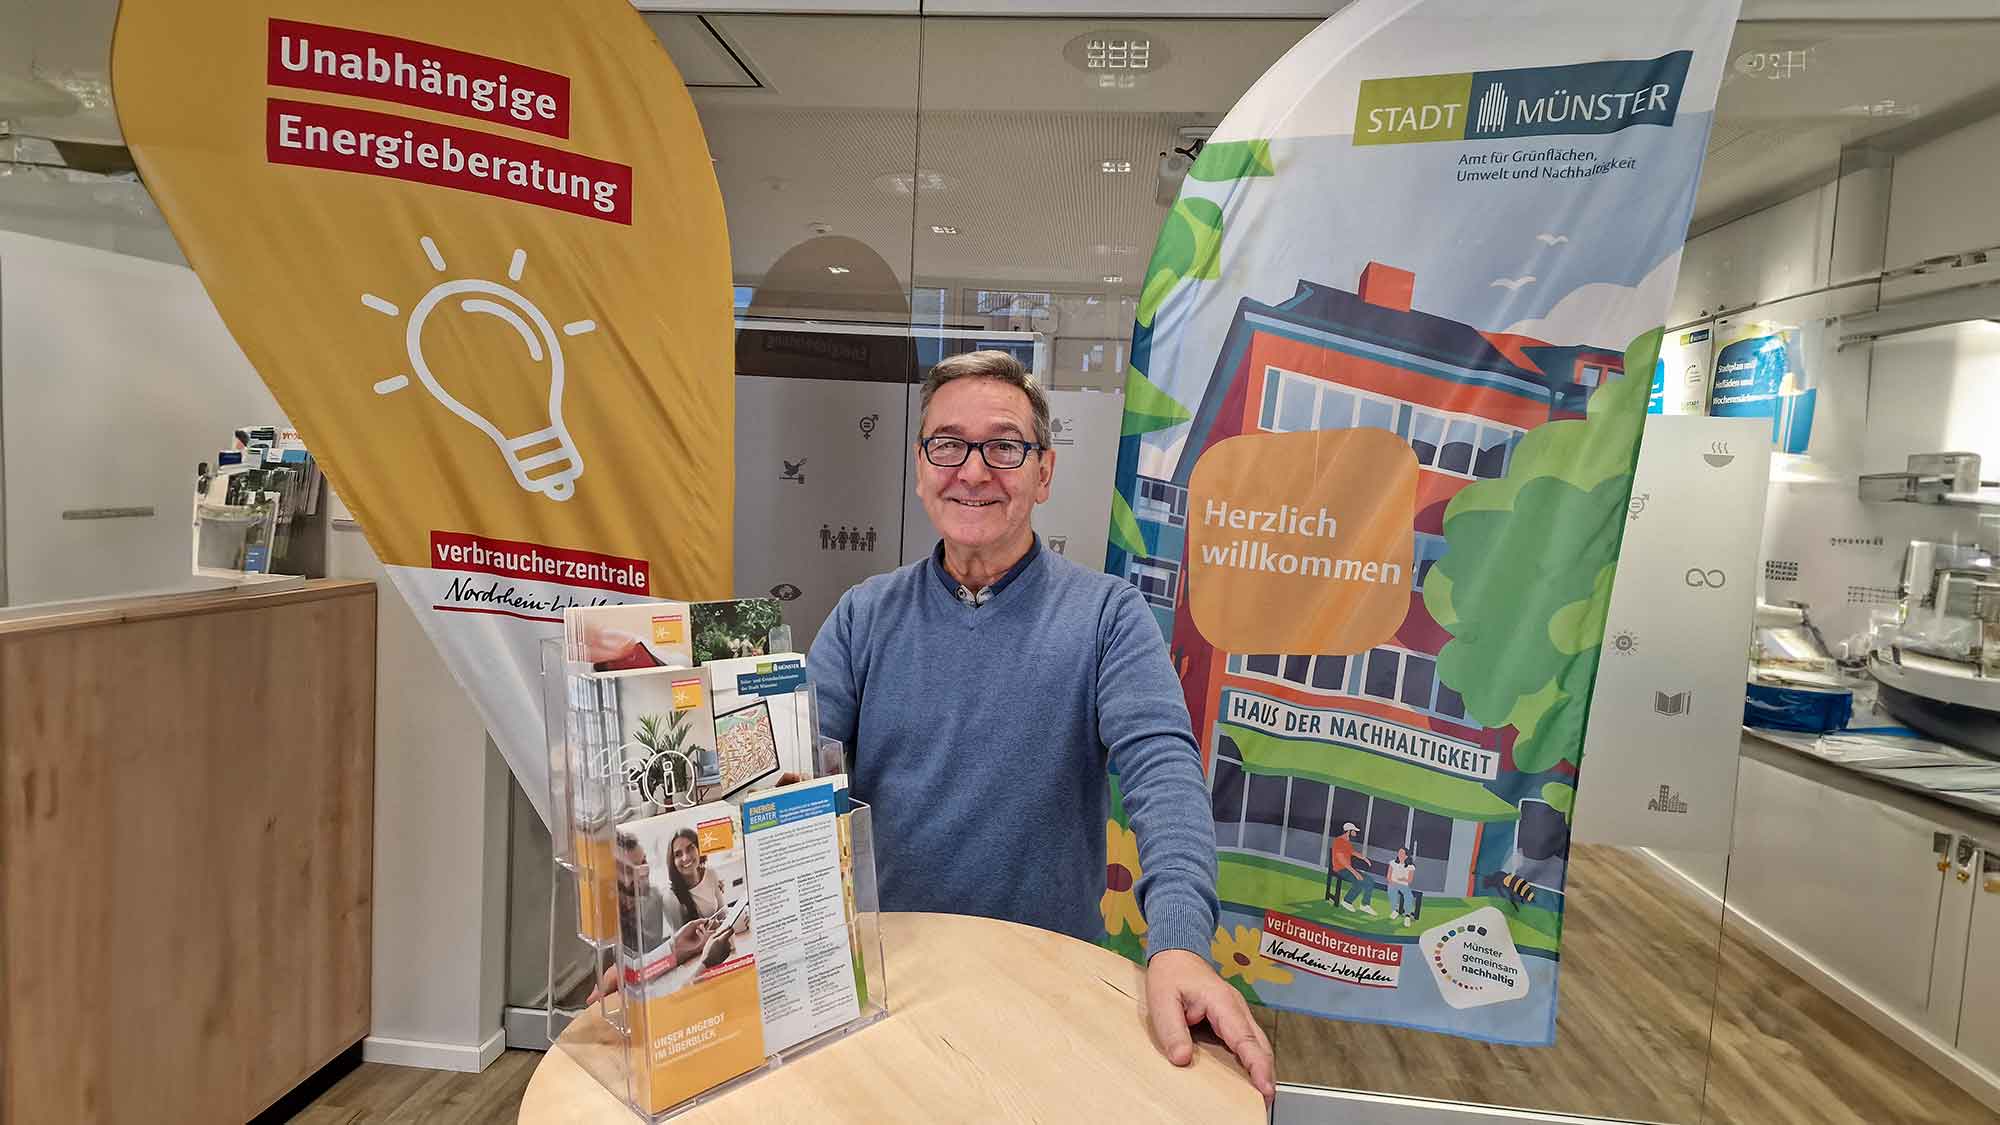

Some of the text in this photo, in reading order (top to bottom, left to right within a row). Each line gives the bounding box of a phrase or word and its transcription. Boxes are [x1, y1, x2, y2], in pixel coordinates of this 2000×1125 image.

[280, 36, 556, 121] Unabhängige
[1368, 84, 1670, 133] STADT MÜNSTER
[279, 114, 617, 213] Energieberatung
[1457, 157, 1637, 182] Umwelt und Nachhaltigkeit
[1458, 148, 1597, 165] Amt für Grünflächen,
[1204, 499, 1337, 538] Herzlich
[437, 541, 646, 588] verbraucherzentrale
[1202, 540, 1401, 585] willkommen
[1233, 697, 1492, 775] HAUS DER NACHHALTIGKEIT
[750, 812, 777, 825] BERATER
[1267, 915, 1398, 962] verbraucherzentrale
[1463, 941, 1503, 959] Münster
[1266, 939, 1393, 984] Nordrhein-Westfalen
[1461, 953, 1518, 976] gemeinsam
[1461, 964, 1515, 988] nachhaltig
[654, 1012, 725, 1049] UNSER ANGEBOT
[655, 1050, 668, 1062] IM
